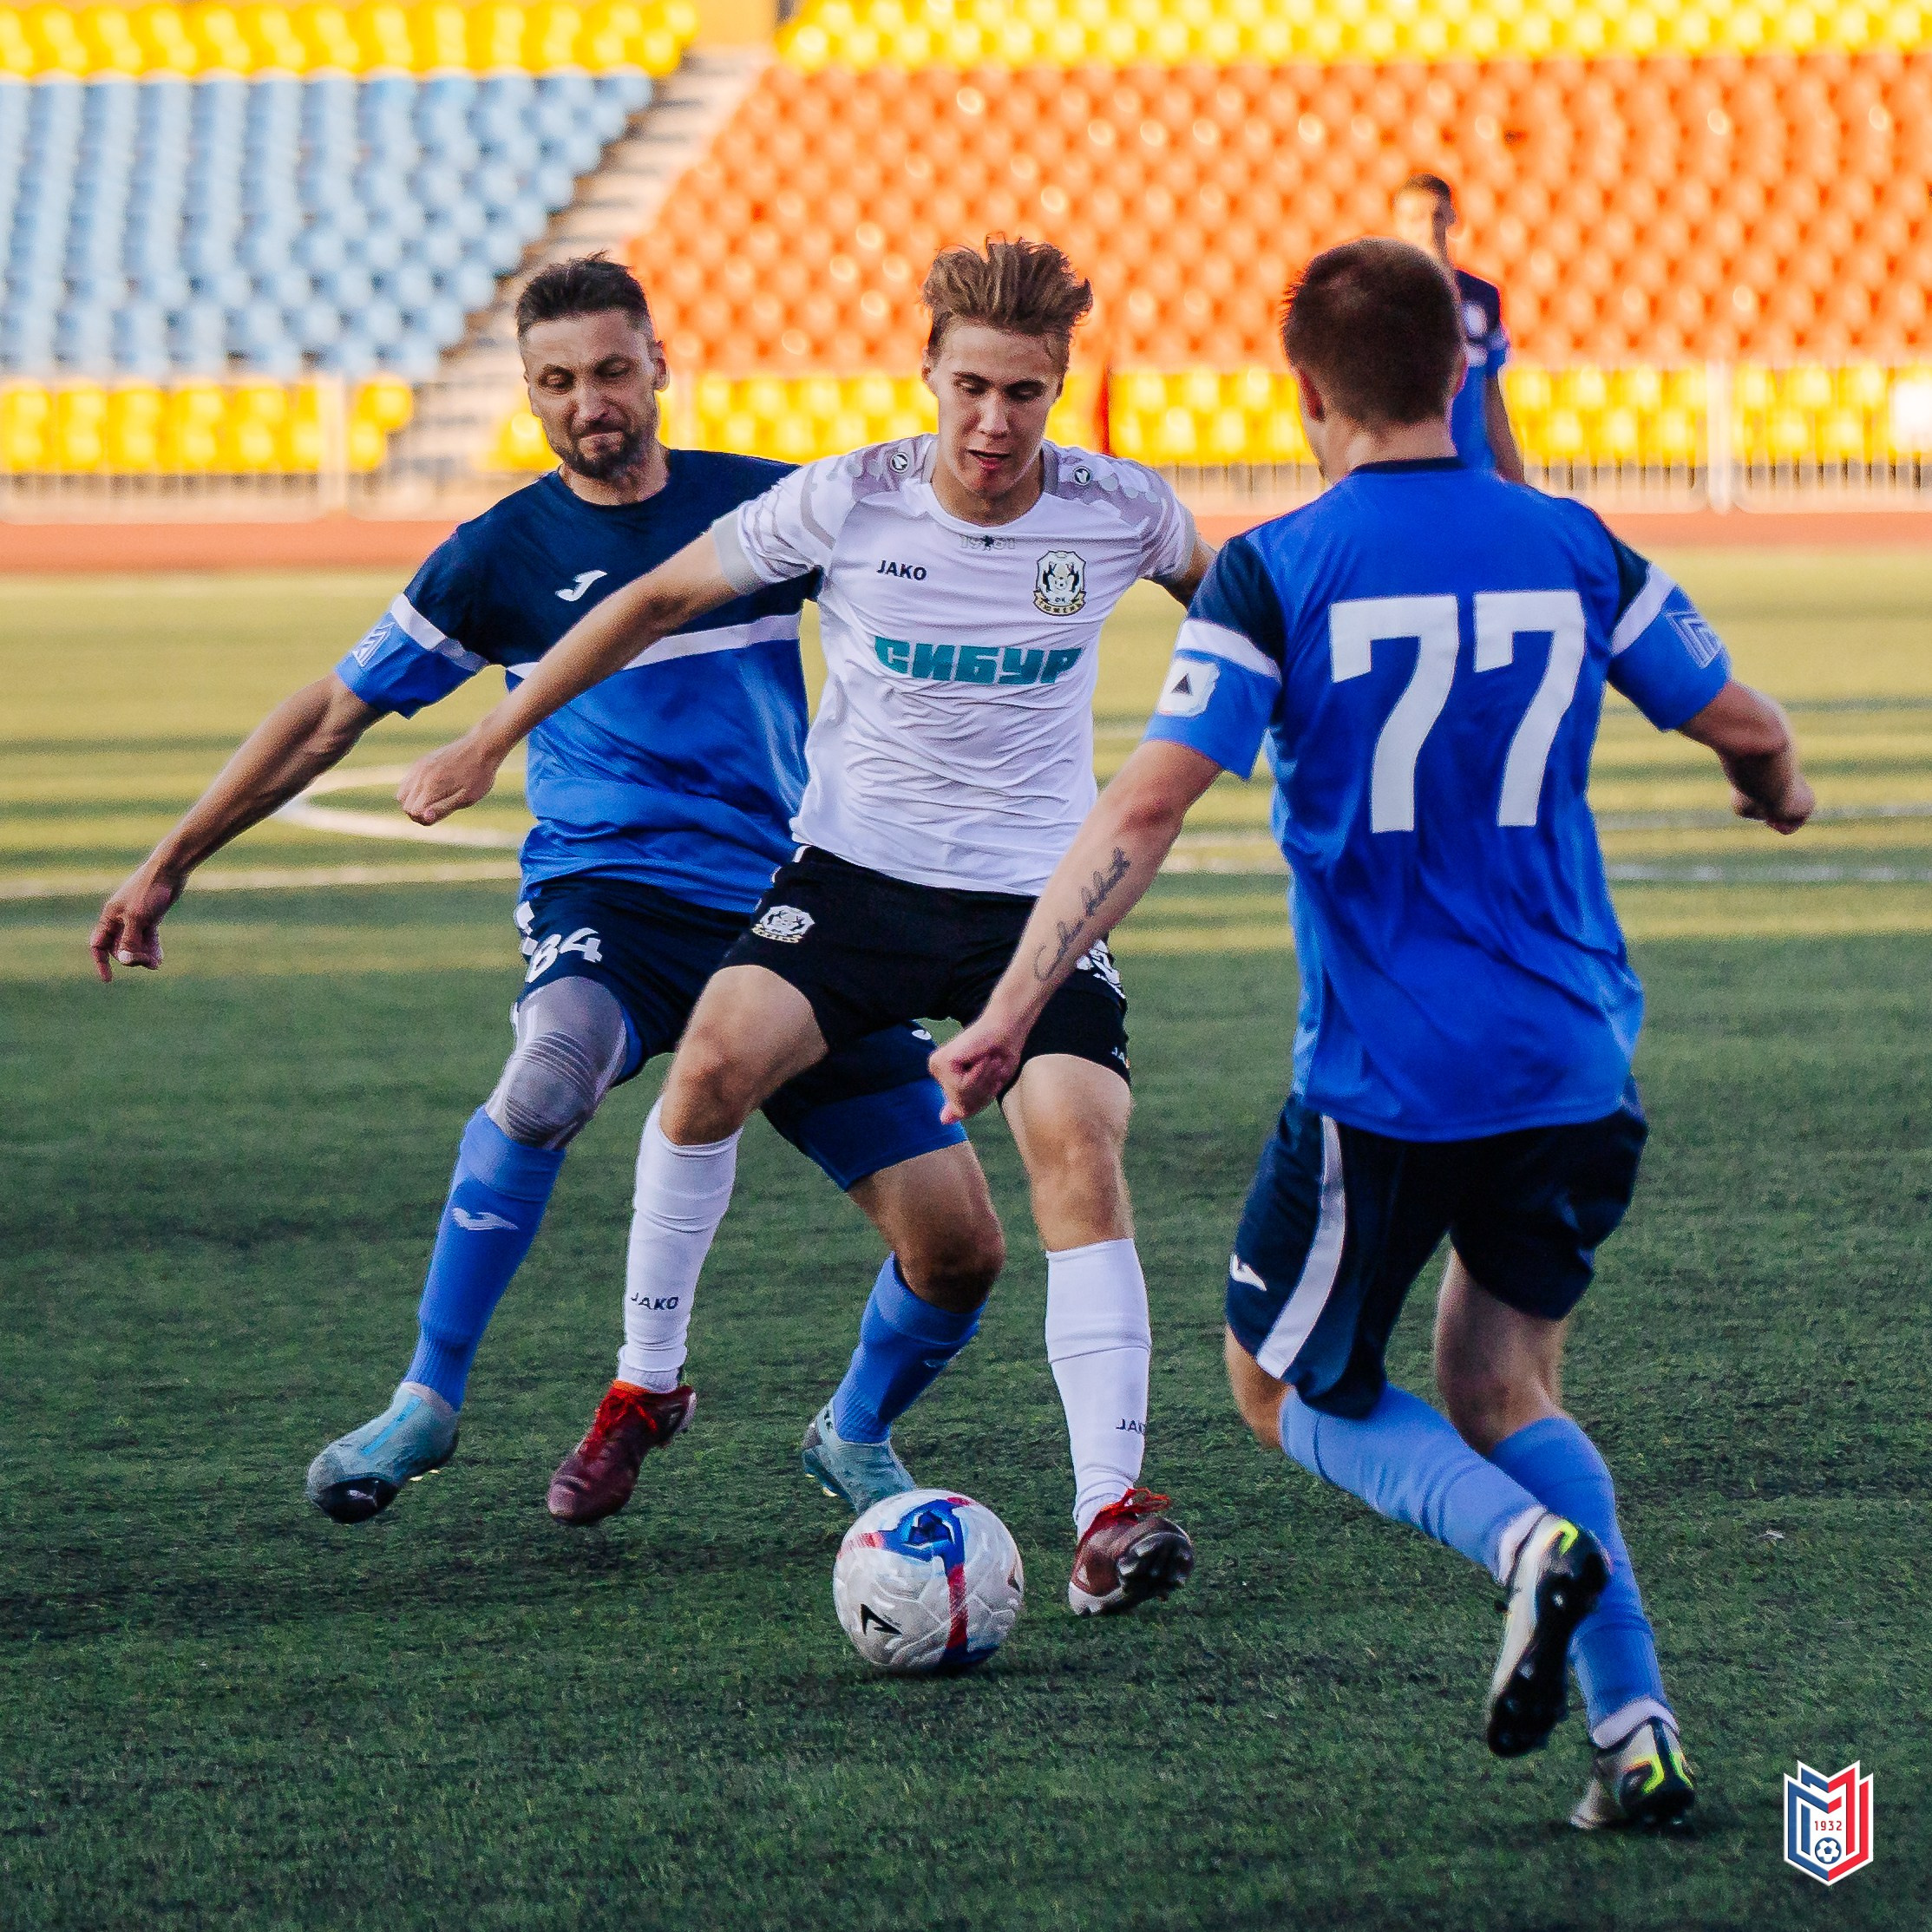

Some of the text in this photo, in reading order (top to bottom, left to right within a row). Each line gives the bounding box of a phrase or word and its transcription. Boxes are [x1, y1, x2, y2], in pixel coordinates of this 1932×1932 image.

[876, 560, 927, 581] JAKO
[874, 636, 1083, 684] СИБУР
[1330, 589, 1586, 833] 77
[525, 927, 602, 983] 84
[630, 1292, 679, 1310] JAKO
